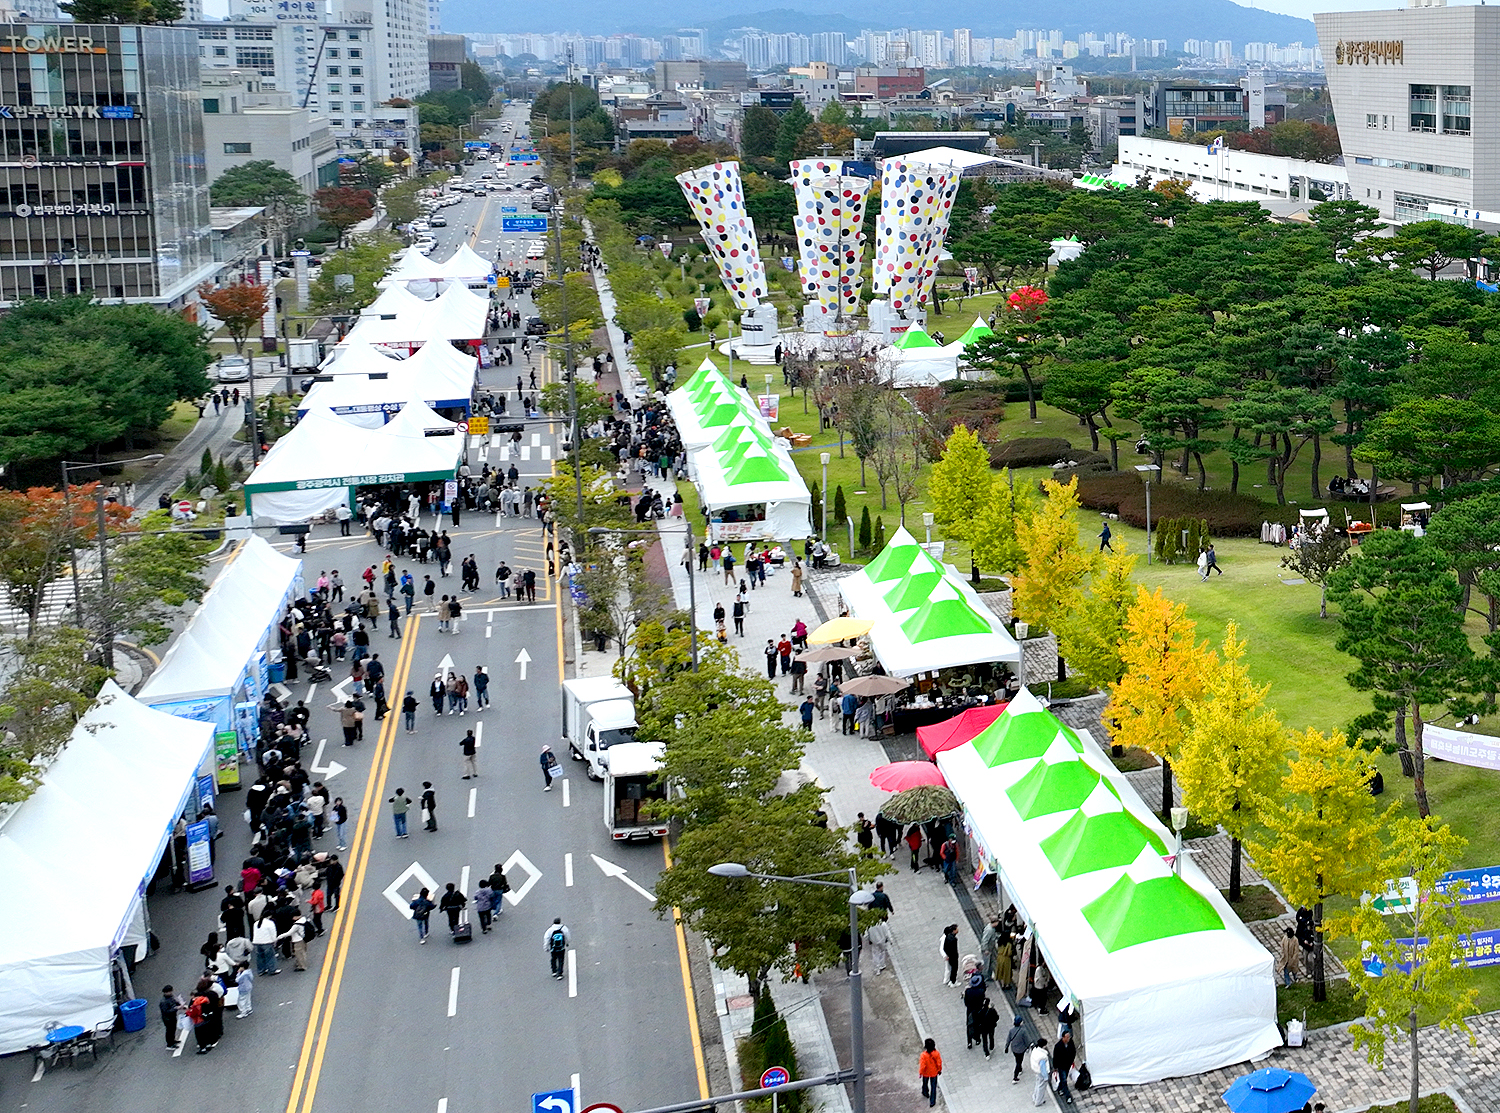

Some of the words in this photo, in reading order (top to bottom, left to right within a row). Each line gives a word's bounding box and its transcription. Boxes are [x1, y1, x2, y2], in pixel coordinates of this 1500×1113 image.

[6, 35, 94, 52] TOWER
[1345, 40, 1403, 65] 광주광역시의회
[1475, 944, 1492, 956] 광주
